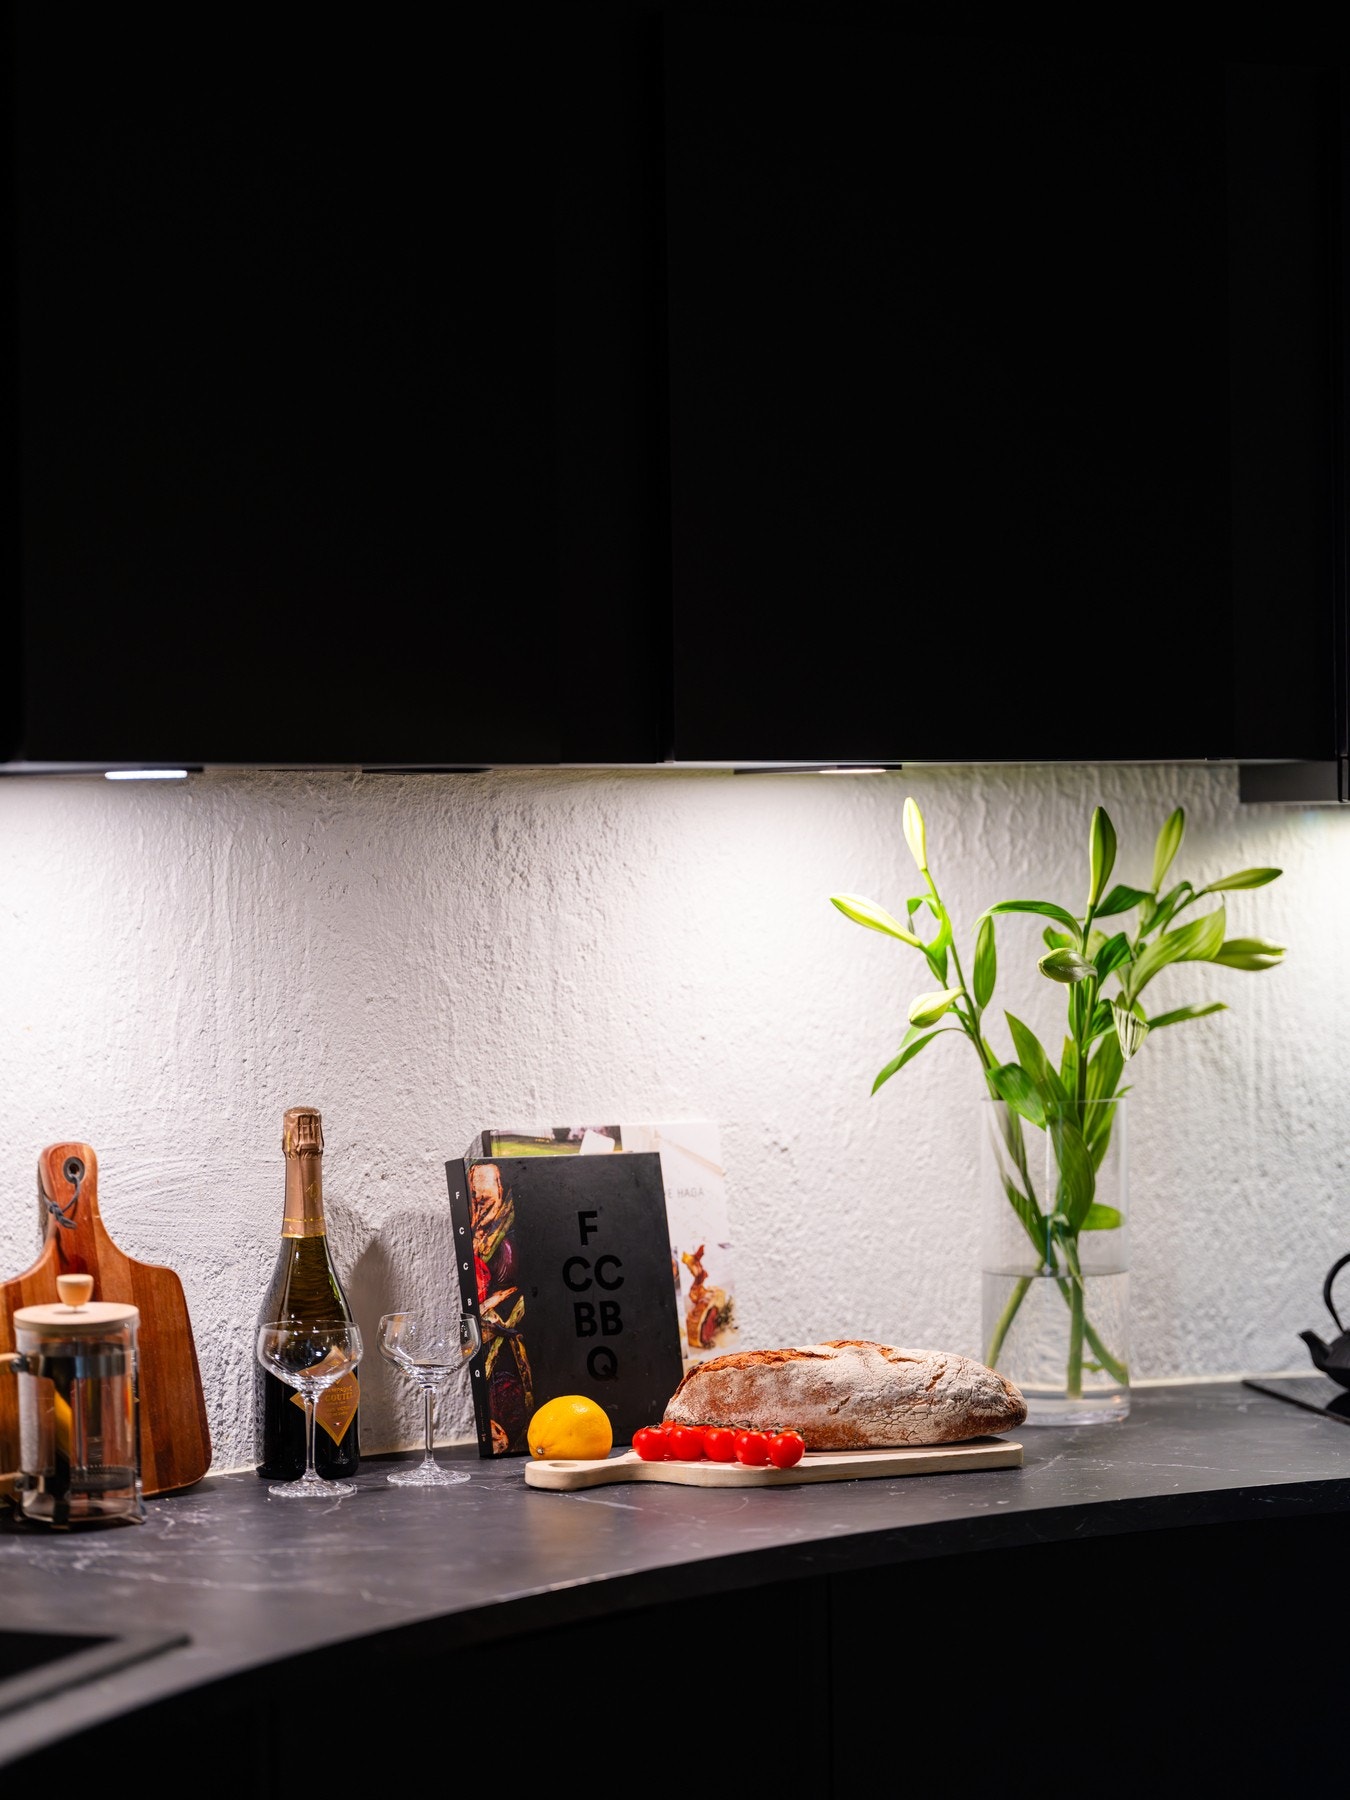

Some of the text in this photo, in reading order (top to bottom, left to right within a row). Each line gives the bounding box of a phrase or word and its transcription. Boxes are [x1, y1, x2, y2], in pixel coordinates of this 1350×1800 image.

[578, 1210, 598, 1246] F
[562, 1255, 625, 1293] CC
[574, 1301, 624, 1338] BB
[587, 1346, 619, 1382] Q
